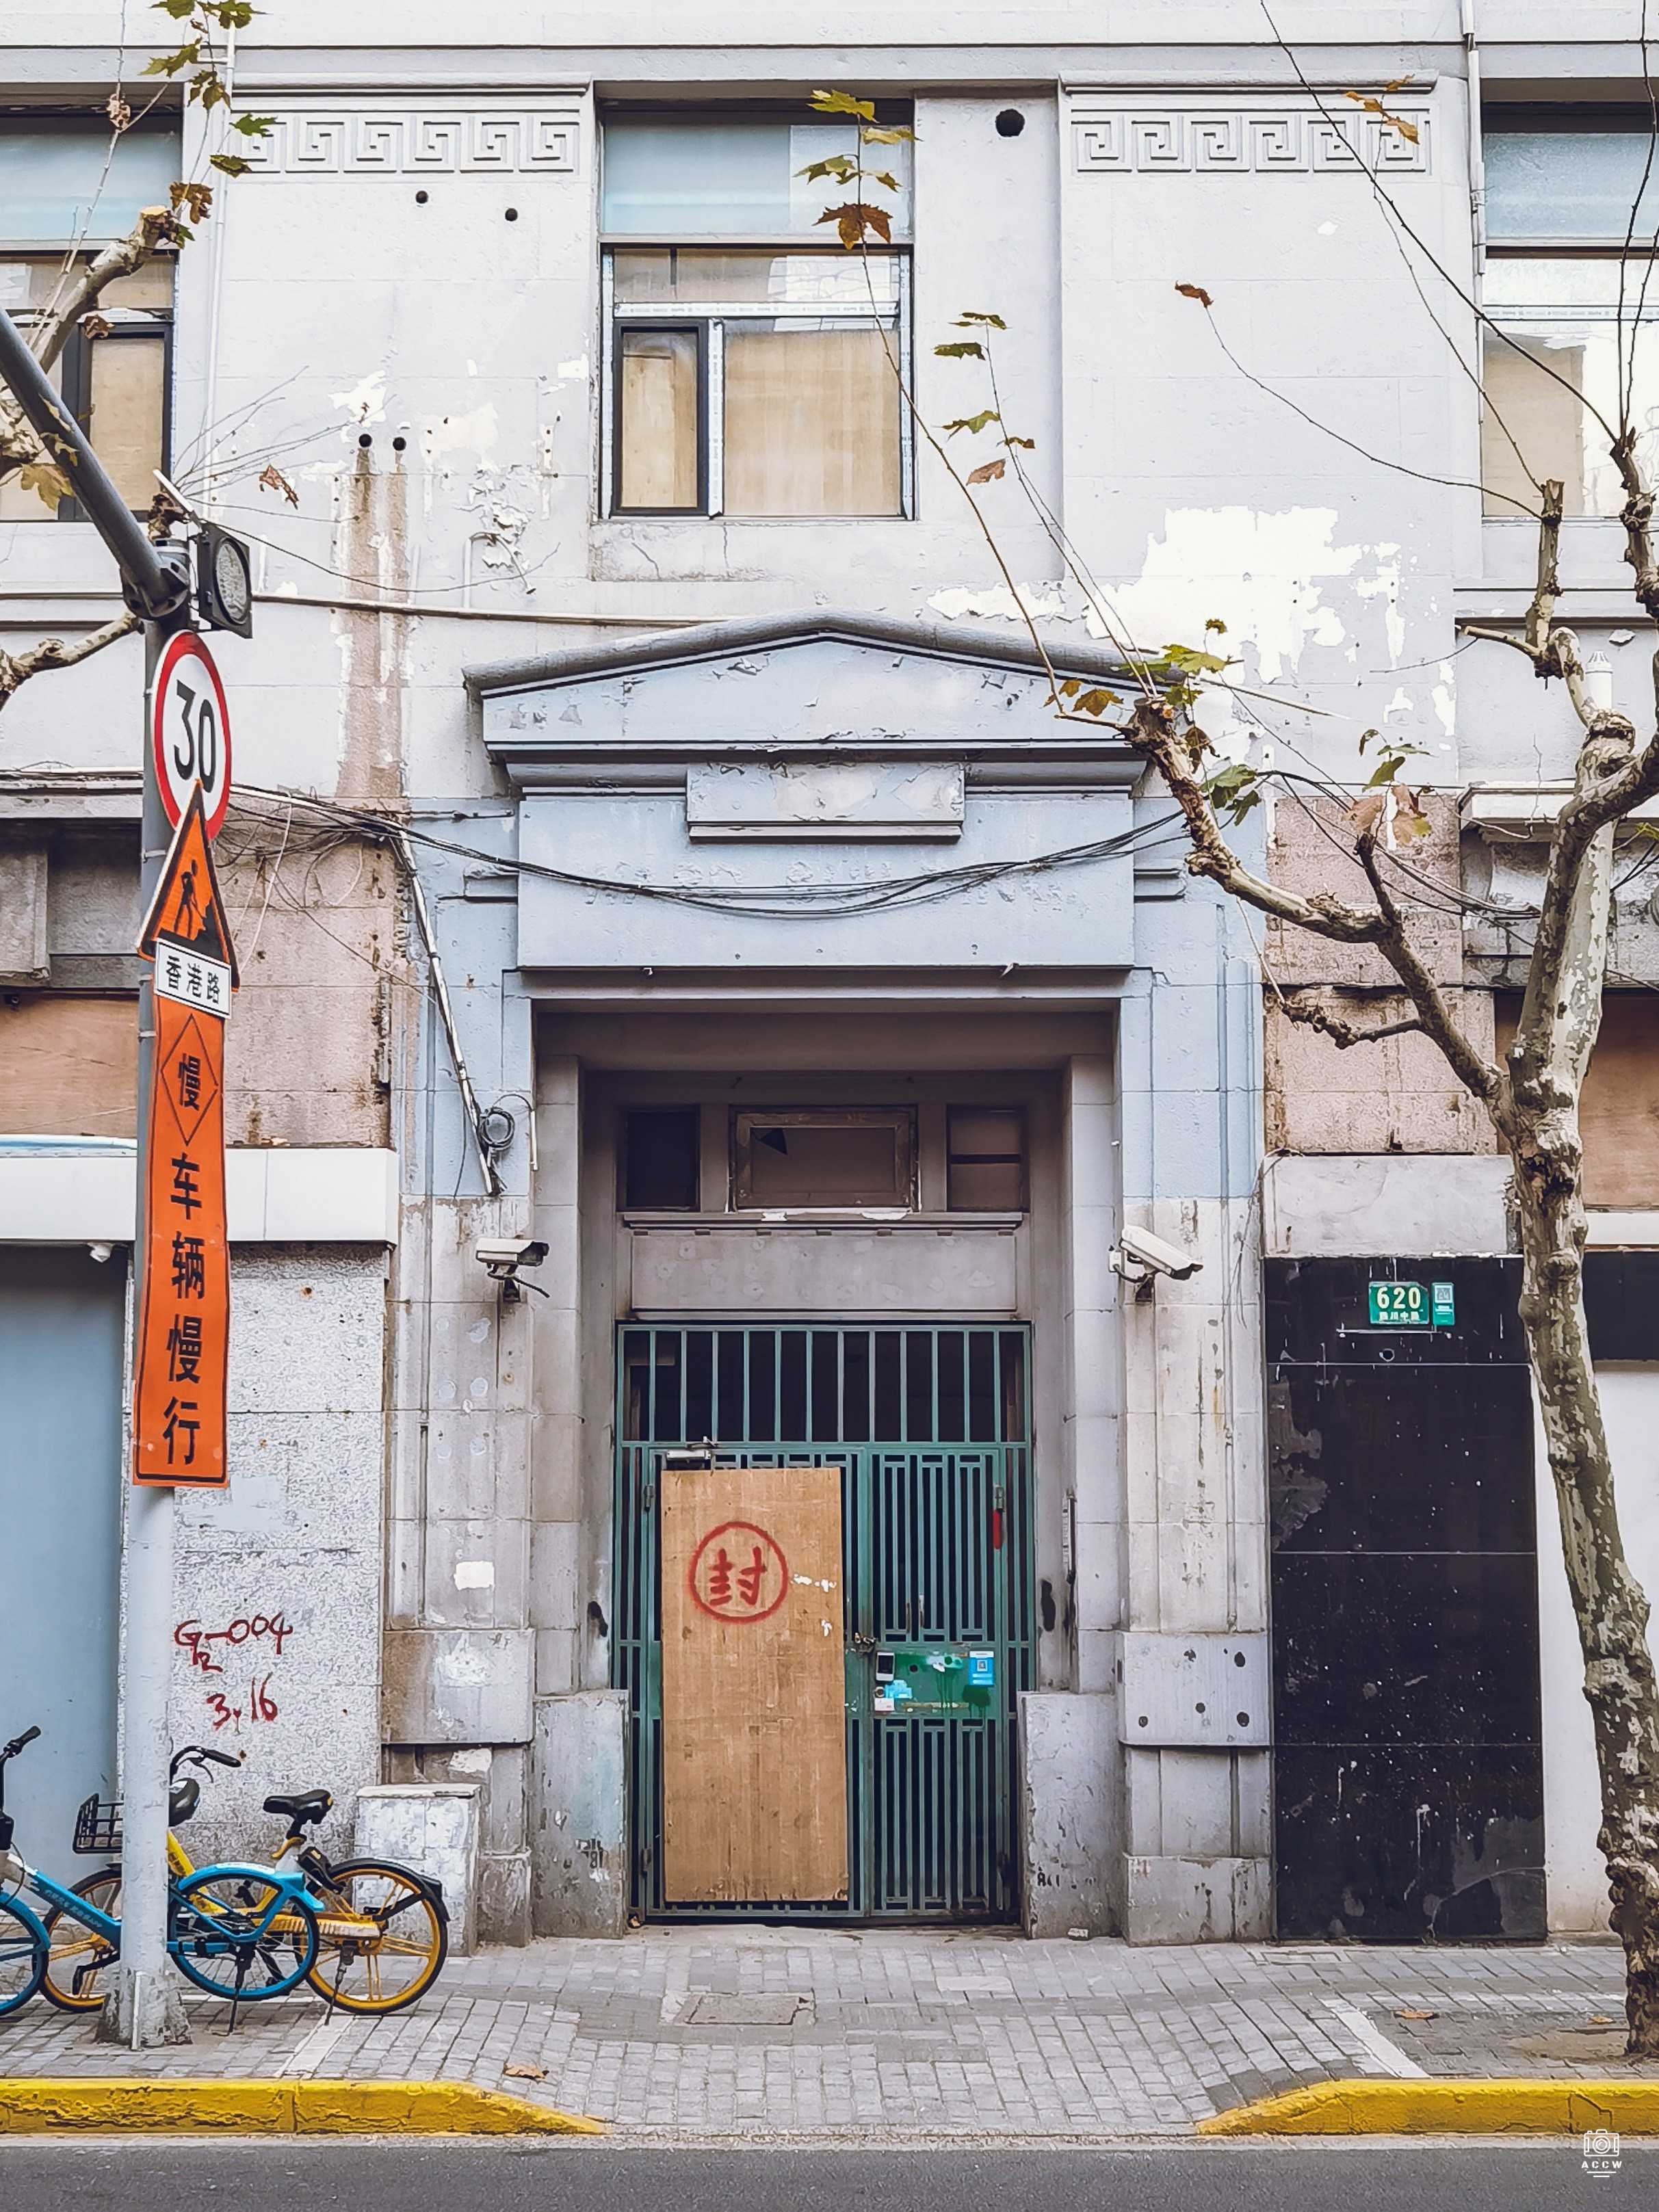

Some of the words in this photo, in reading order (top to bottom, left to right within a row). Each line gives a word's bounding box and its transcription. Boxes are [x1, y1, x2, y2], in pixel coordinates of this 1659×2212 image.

[173, 679, 216, 793] 30
[166, 955, 220, 1004] 香港路
[177, 1052, 201, 1111] 慢
[162, 1151, 205, 1466] 车辆慢行
[1376, 1286, 1421, 1309] 620
[709, 1545, 767, 1606] 封
